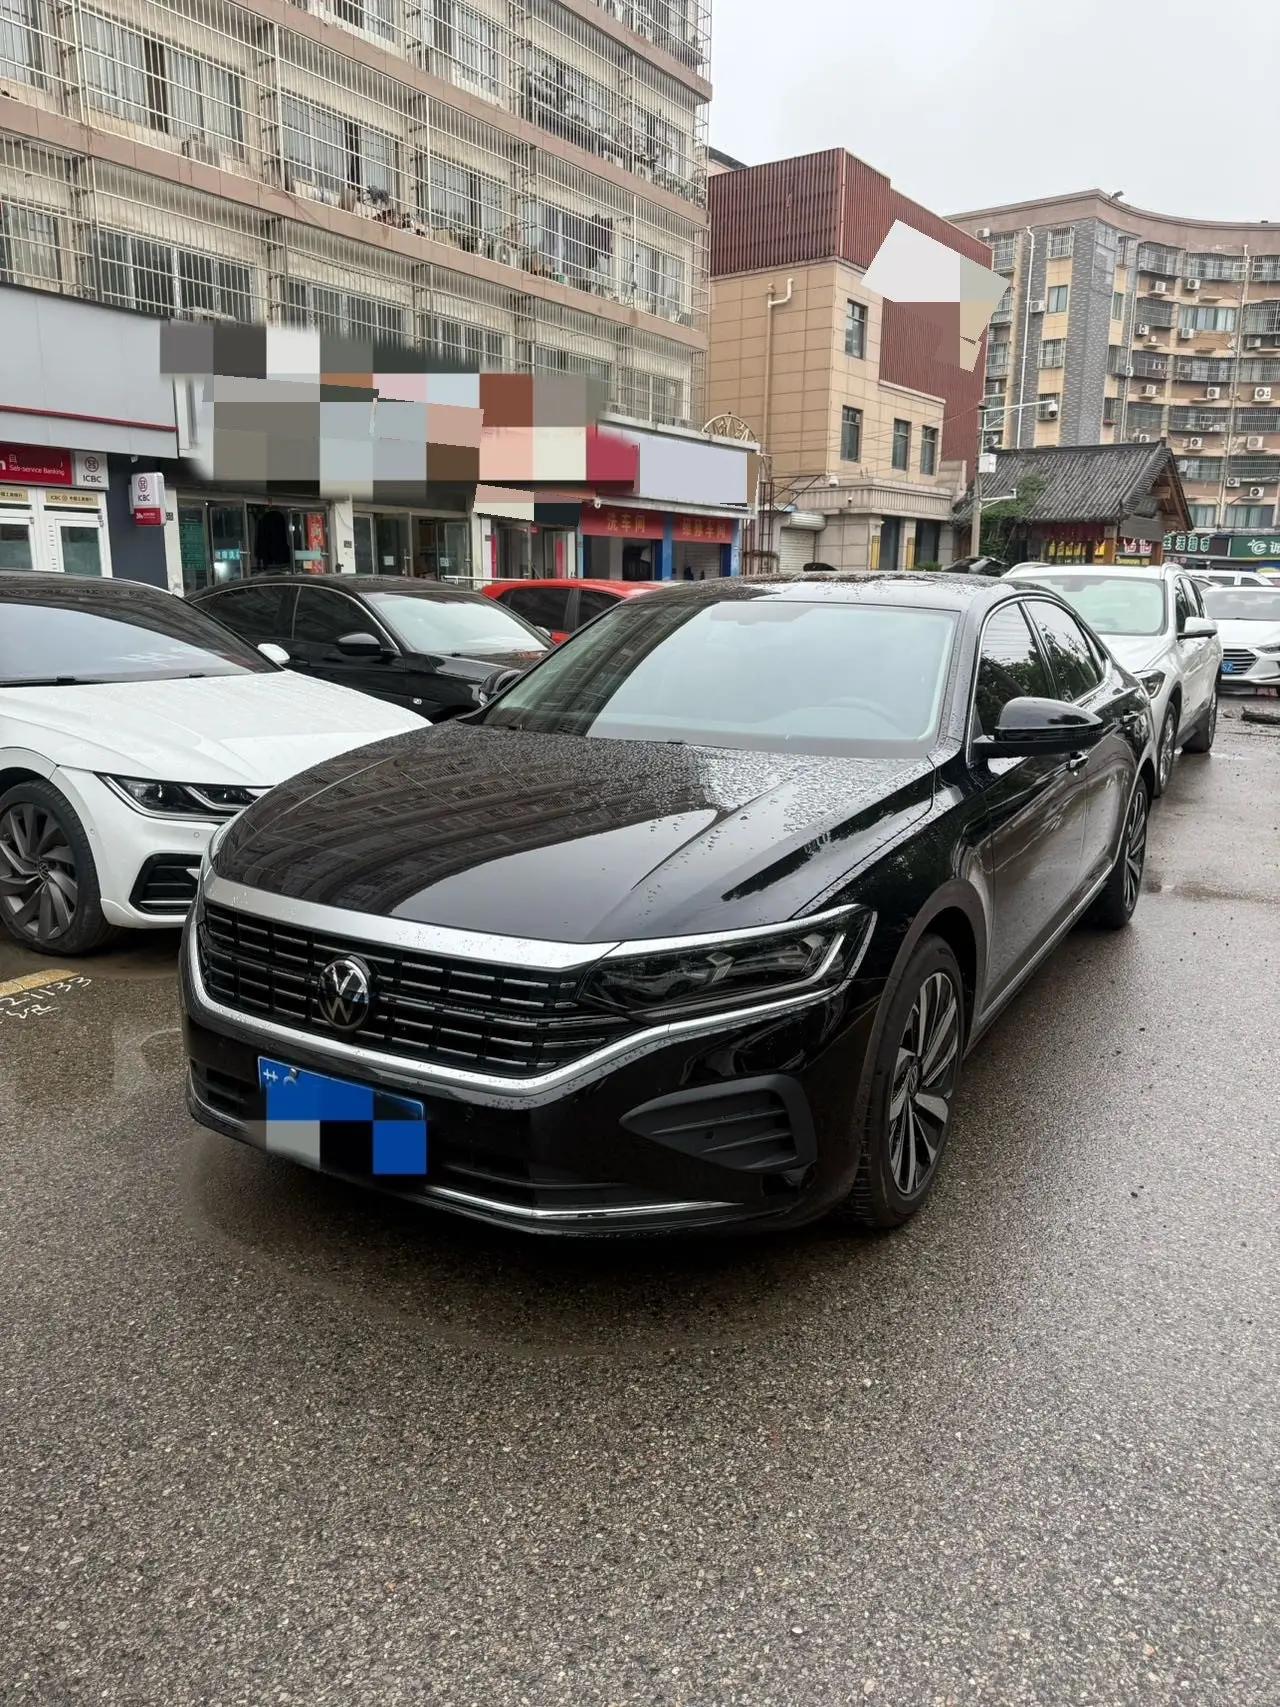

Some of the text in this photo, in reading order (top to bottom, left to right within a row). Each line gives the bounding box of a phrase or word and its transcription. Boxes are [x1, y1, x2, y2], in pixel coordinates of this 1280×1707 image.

[82, 474, 102, 483] ICBC
[137, 493, 151, 502] ICBC
[606, 511, 646, 534] 洗车间
[1162, 534, 1210, 553] 生活超市
